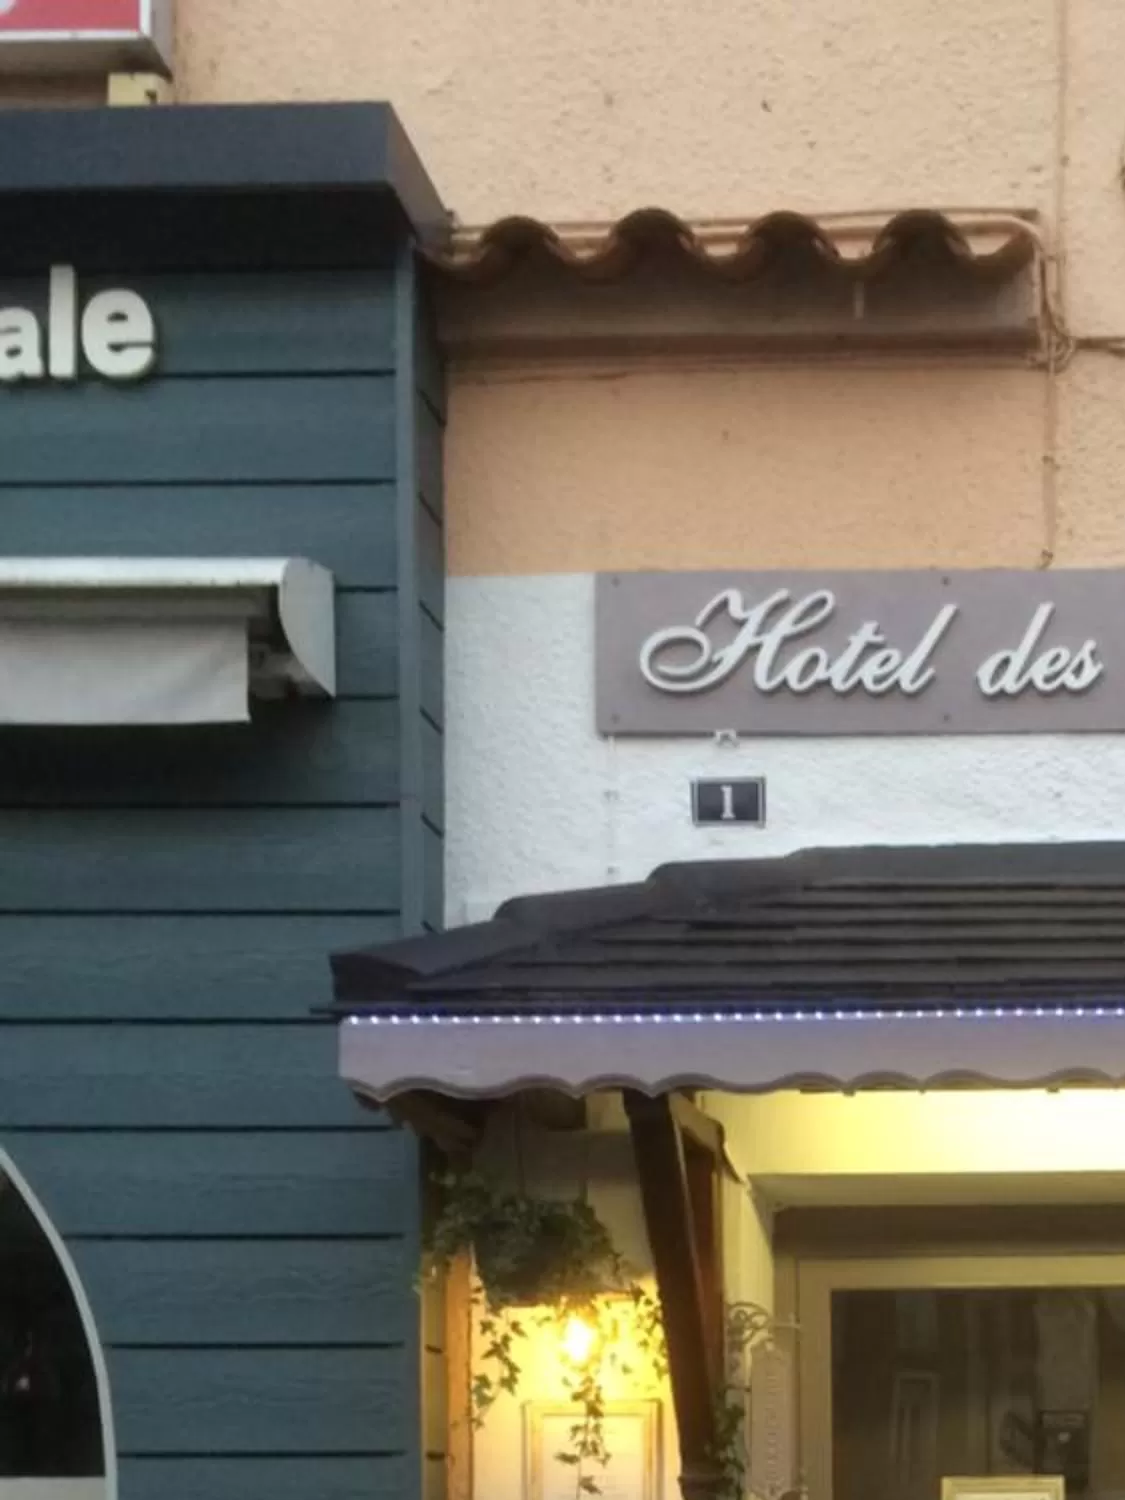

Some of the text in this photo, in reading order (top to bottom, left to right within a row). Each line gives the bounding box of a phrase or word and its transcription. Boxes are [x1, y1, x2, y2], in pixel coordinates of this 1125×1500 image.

[640, 588, 958, 698] Hotel
[975, 602, 1103, 697] des
[720, 785, 736, 819] 1
